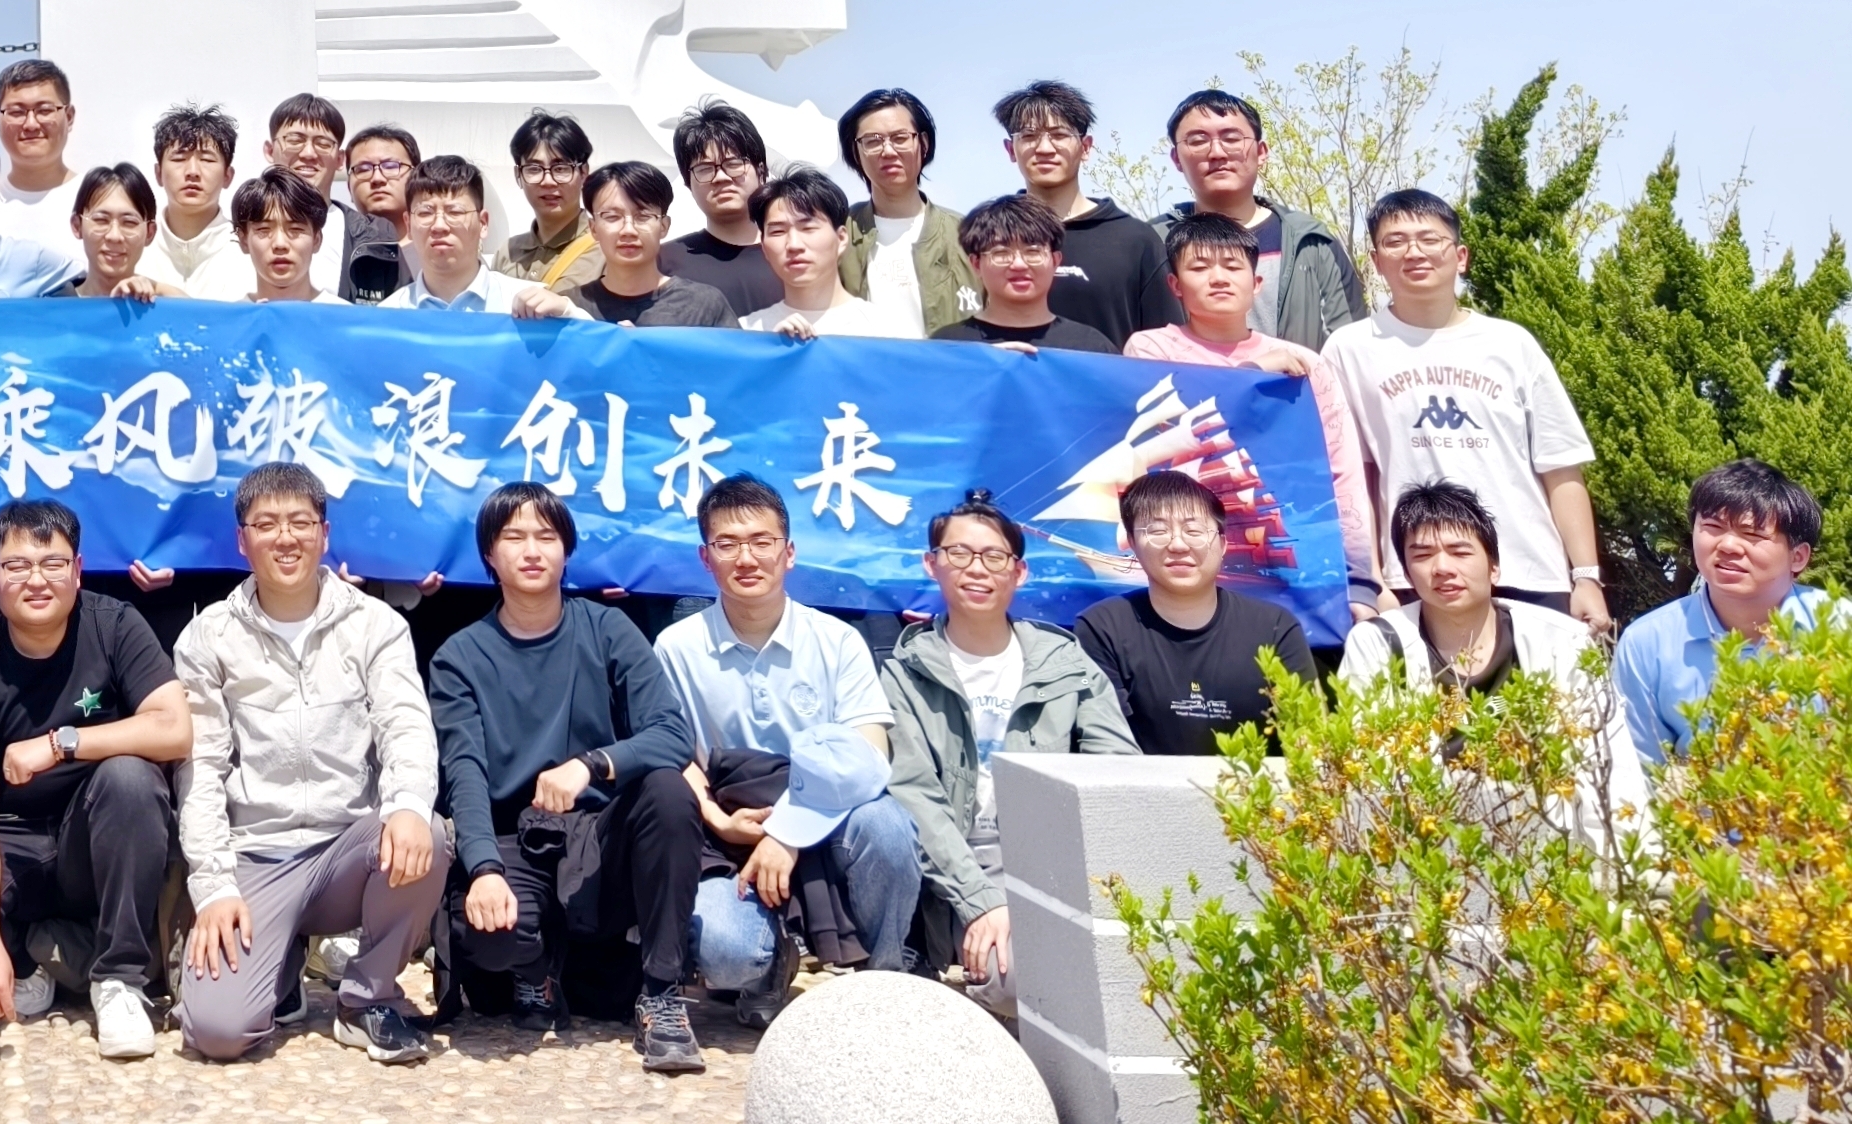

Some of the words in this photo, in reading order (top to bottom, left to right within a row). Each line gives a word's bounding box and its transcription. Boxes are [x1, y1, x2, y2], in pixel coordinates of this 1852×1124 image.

[956, 285, 980, 312] NY
[1379, 368, 1424, 400] KAPPA
[1426, 365, 1503, 400] AUTHENTIC
[1411, 435, 1453, 449] SINCE
[1459, 437, 1490, 449] 1967
